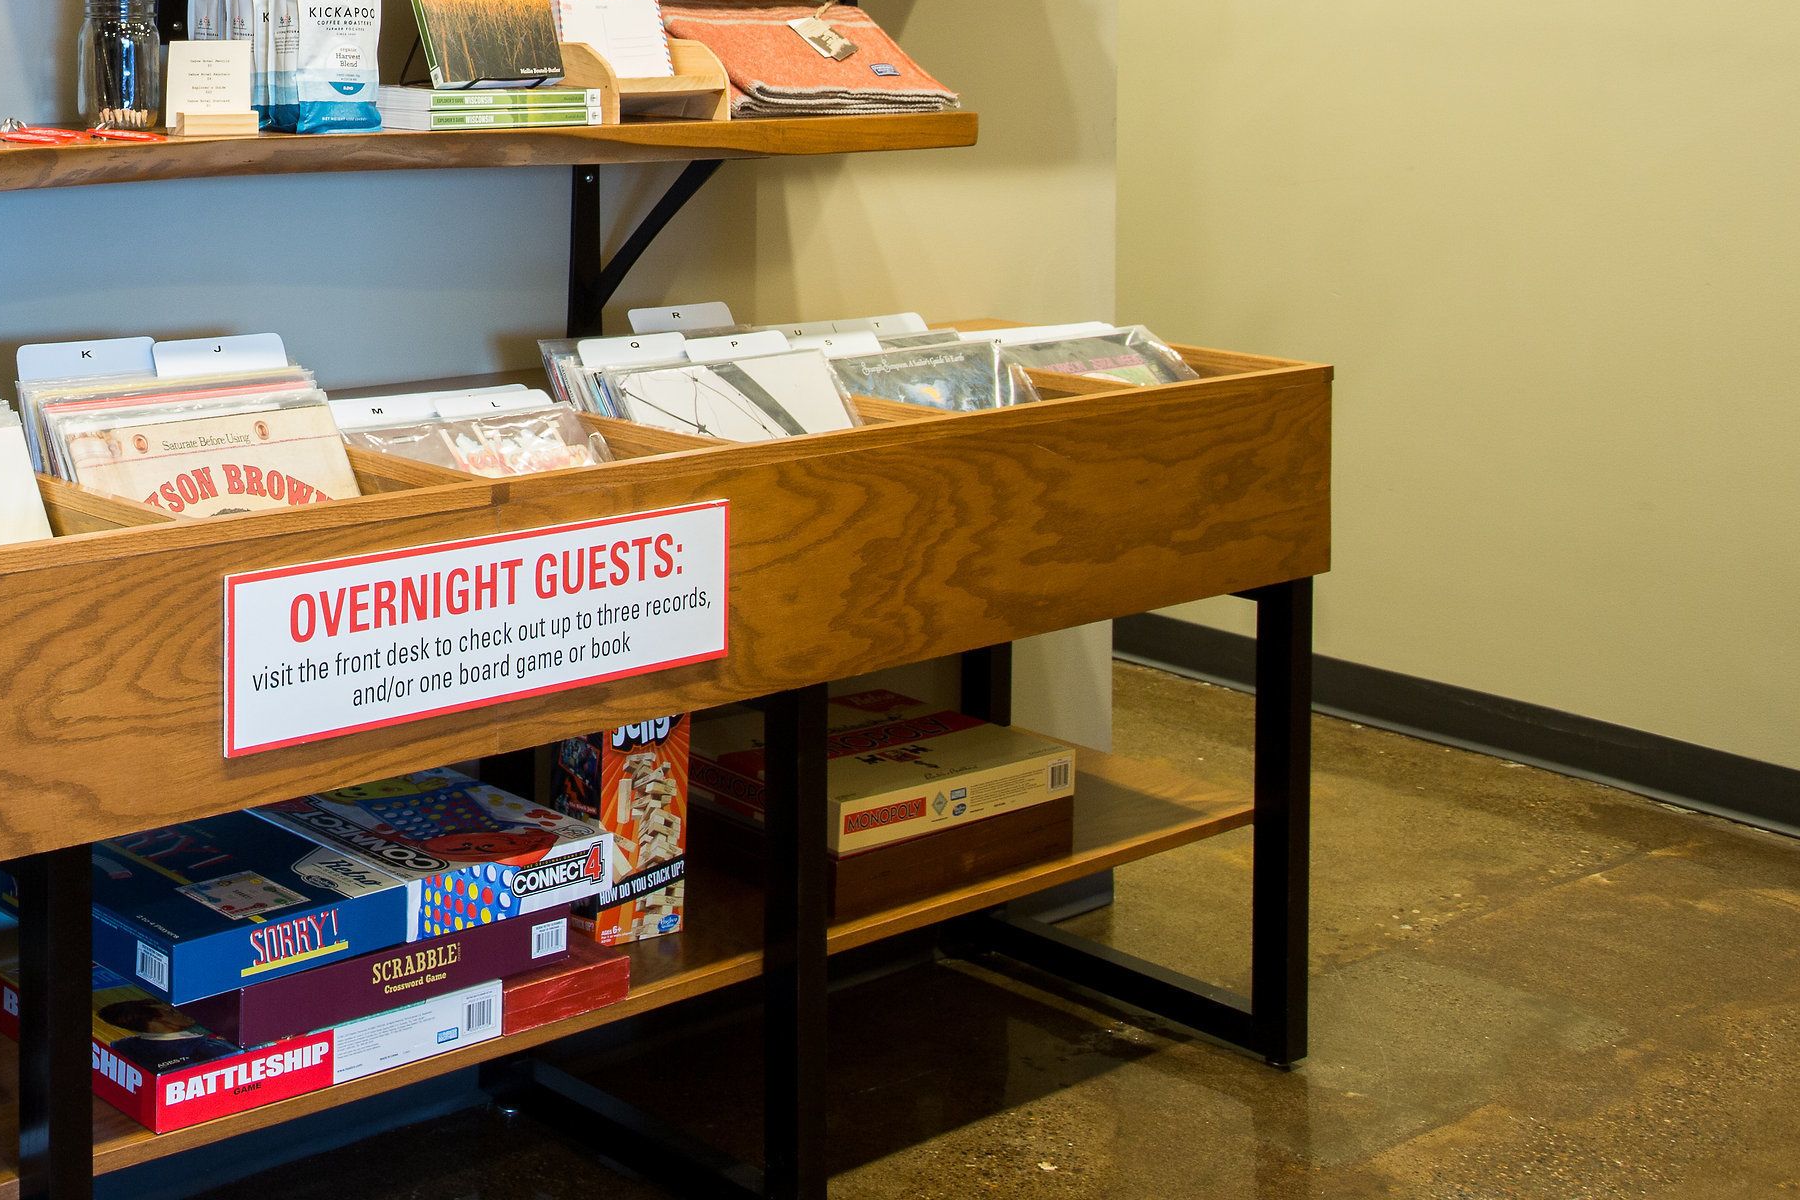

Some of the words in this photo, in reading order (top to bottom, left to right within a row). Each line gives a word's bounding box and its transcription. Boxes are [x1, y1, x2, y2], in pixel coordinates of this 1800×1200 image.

[672, 311, 681, 319] R
[81, 350, 93, 359] K
[213, 345, 222, 353] J
[630, 341, 641, 350] Q
[491, 401, 501, 409] L
[162, 437, 198, 451] Saturate
[198, 435, 225, 448] Before
[226, 433, 251, 448] Using
[289, 558, 523, 643] OVERNIGHT
[535, 533, 683, 600] GUESTS:
[252, 660, 293, 692] visit
[298, 656, 330, 683] the
[335, 645, 381, 677] front
[387, 636, 430, 668] desk
[435, 634, 452, 658] to
[459, 621, 513, 653] check
[518, 615, 546, 640] out
[550, 613, 572, 641] up
[576, 605, 593, 629] to
[597, 598, 640, 627] three
[645, 587, 712, 618] records,
[352, 671, 412, 707] and/or
[420, 667, 453, 690] one
[459, 653, 510, 686] board
[515, 648, 563, 680] game
[569, 643, 585, 664] or
[591, 631, 631, 660] book
[846, 800, 923, 834] MONOPOLY
[317, 858, 383, 887] Retro
[514, 858, 586, 894] CONNECT
[600, 886, 618, 907] HOW
[620, 883, 631, 899] DO
[630, 876, 647, 896] YOU
[647, 868, 671, 888] STACK
[671, 860, 685, 880] UP?
[249, 908, 339, 967] SORRY!
[372, 943, 458, 985] SCRABBLE
[383, 977, 424, 995] Crossword
[425, 972, 447, 985] Game
[165, 1041, 329, 1106] BATTLESHIP
[233, 1081, 262, 1096] GAME
